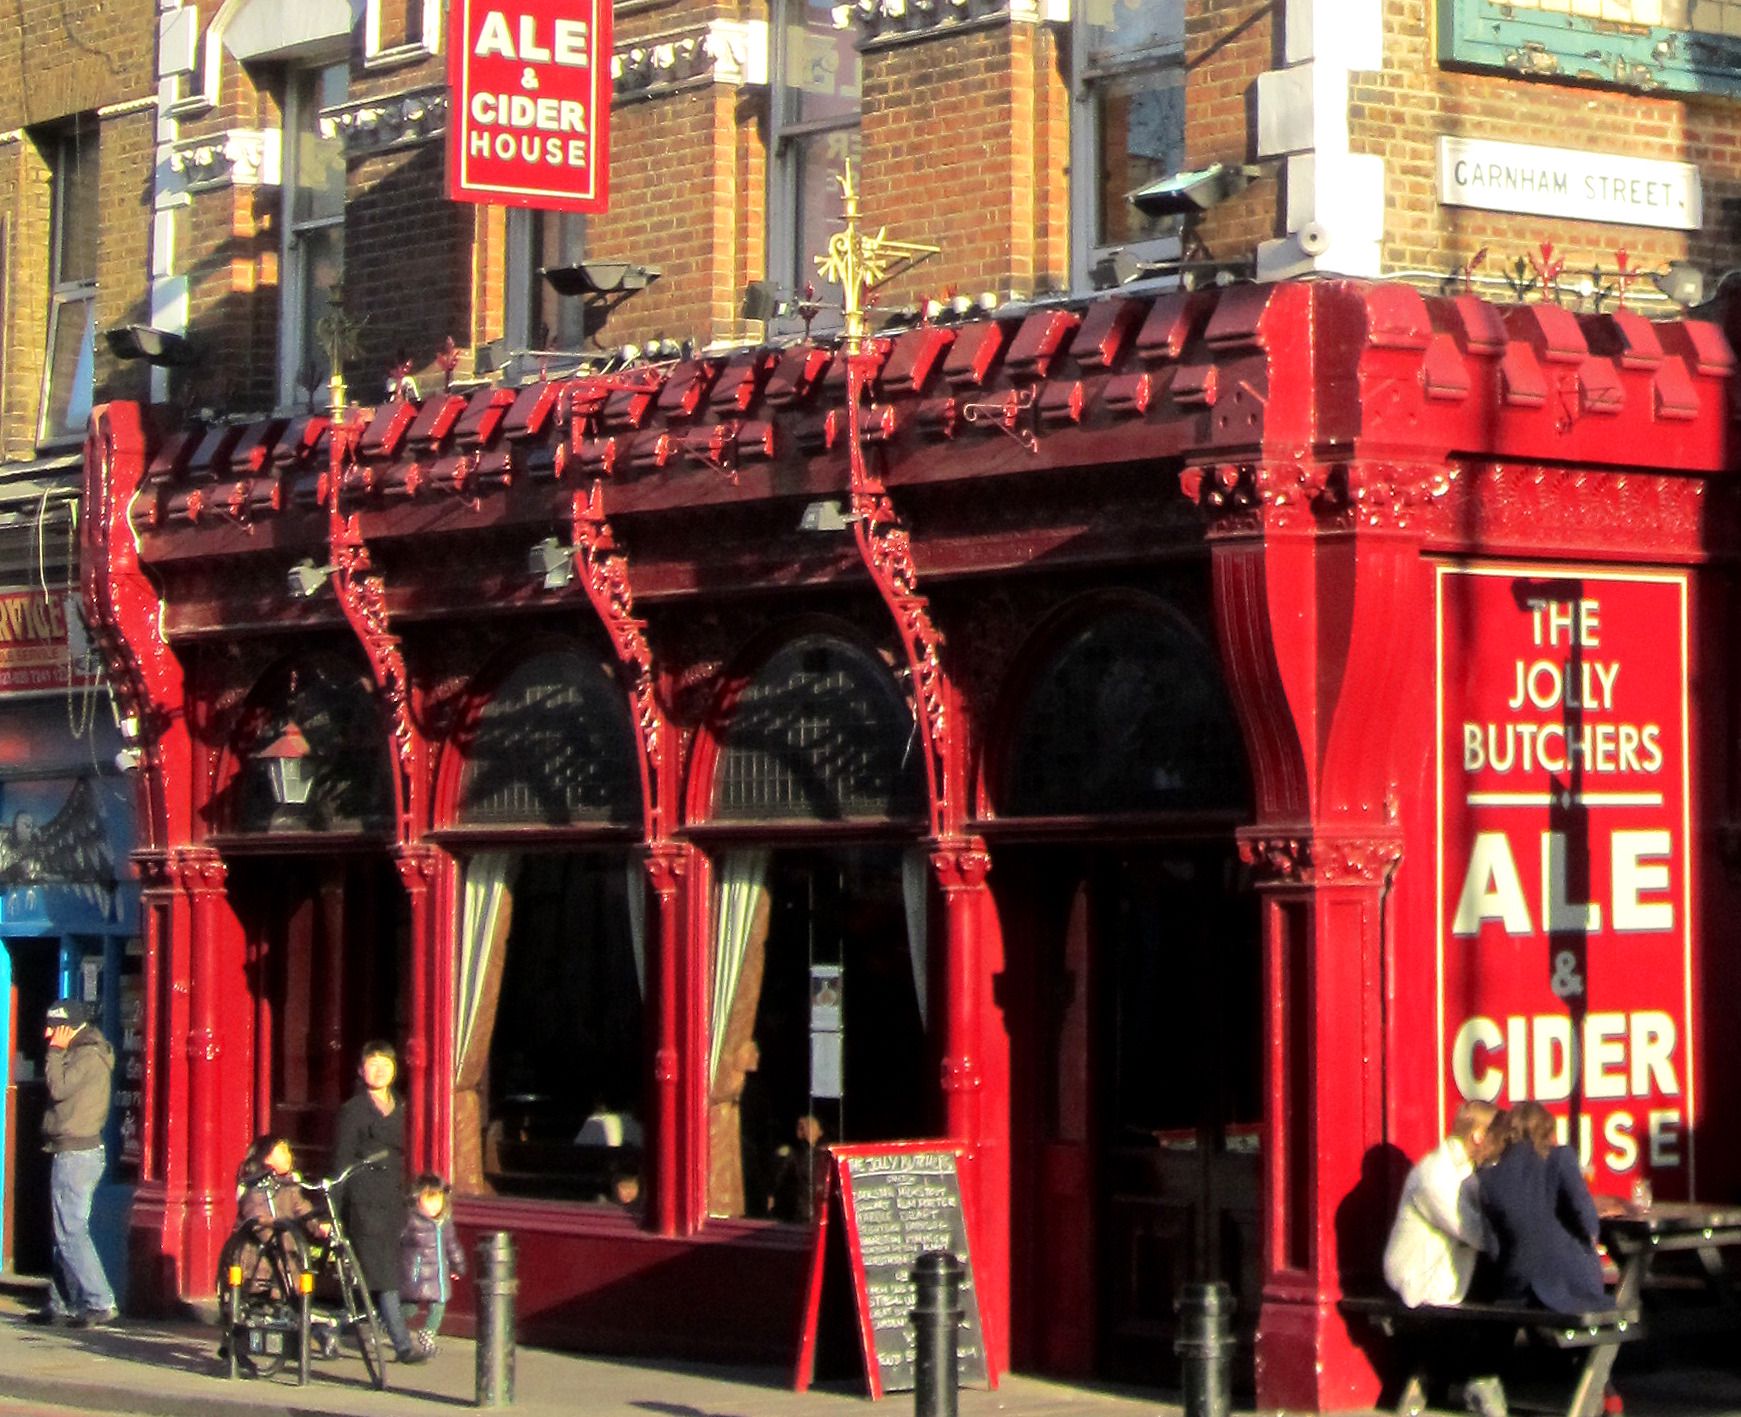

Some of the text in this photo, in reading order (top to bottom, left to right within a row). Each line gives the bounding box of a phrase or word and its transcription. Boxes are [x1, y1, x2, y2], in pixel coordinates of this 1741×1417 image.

[475, 11, 588, 66] ALE
[520, 67, 540, 90] &
[471, 91, 588, 134] CIDER
[470, 131, 586, 167] HOUSE
[1526, 598, 1600, 647] THE
[1508, 659, 1620, 711] JOLLY
[1463, 722, 1664, 772] BUTCHERS
[1452, 830, 1675, 936] ALE
[1551, 950, 1584, 997] &
[1452, 1010, 1681, 1103] CIDER
